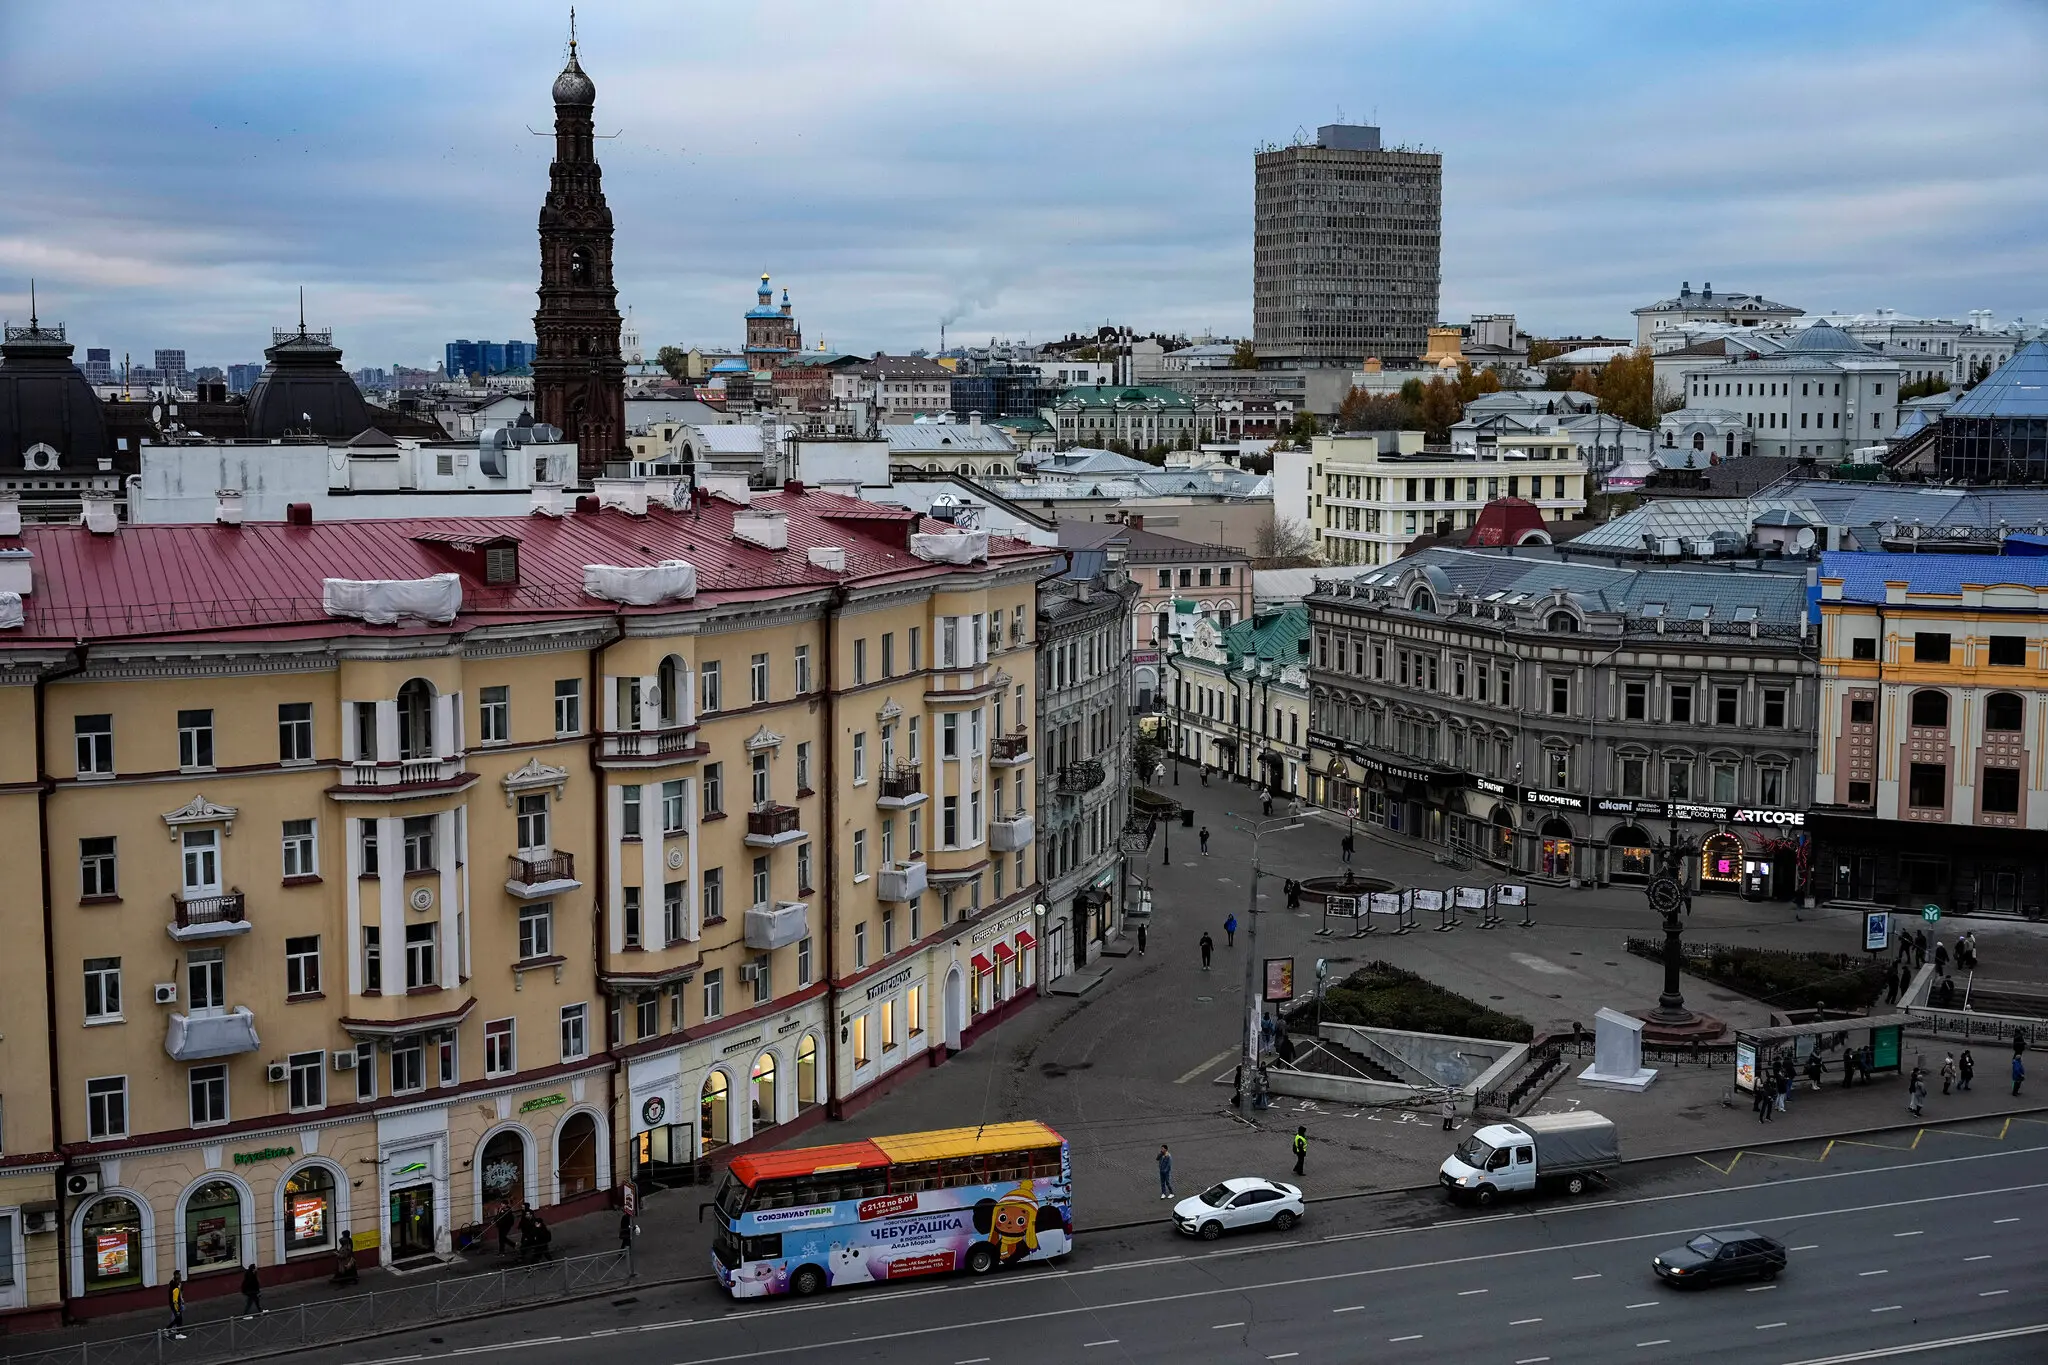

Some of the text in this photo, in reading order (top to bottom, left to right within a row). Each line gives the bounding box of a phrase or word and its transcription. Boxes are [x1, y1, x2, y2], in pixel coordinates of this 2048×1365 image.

[1355, 755, 1430, 782] ТОРГОВЫЙ КОМПЛЕКС
[1484, 782, 1505, 794] МАГНИТ
[1539, 794, 1582, 808] КОСМЕТИК
[1599, 799, 1633, 811] akami
[1712, 812, 1727, 820] FUN
[1732, 809, 1805, 825] ARTCORE
[866, 967, 913, 1000] ТАТПРОДУКТ
[234, 1146, 295, 1165] ВкусВилл
[867, 1201, 886, 1211] 21.12
[887, 1199, 897, 1207] по
[876, 1205, 902, 1215] 2024-2025
[756, 1206, 832, 1222] СОЮЗМУЛЬТПАРК
[870, 1218, 963, 1240] ЧЕБУРАШКА
[891, 1239, 936, 1250] Деда Мороза
[906, 1234, 932, 1243] поисках
